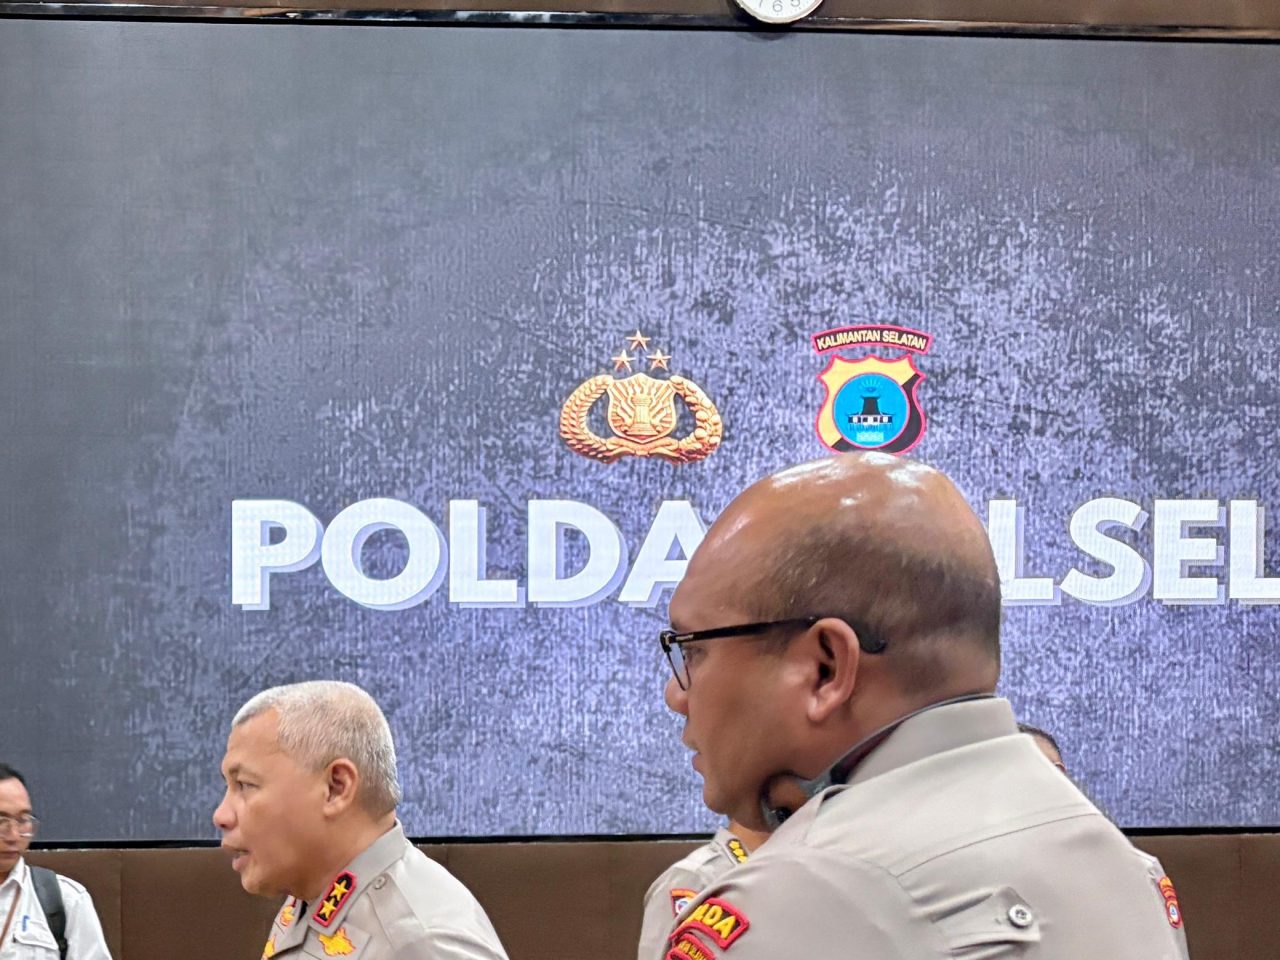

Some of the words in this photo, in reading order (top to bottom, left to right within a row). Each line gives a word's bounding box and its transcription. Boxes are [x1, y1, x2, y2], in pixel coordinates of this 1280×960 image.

[772, 0, 783, 12] 6
[816, 330, 881, 350] KALIMANTAN
[882, 330, 927, 350] SELATAN
[231, 497, 708, 610] POLDA
[988, 497, 1280, 607] LSEL
[686, 903, 736, 940] LDA
